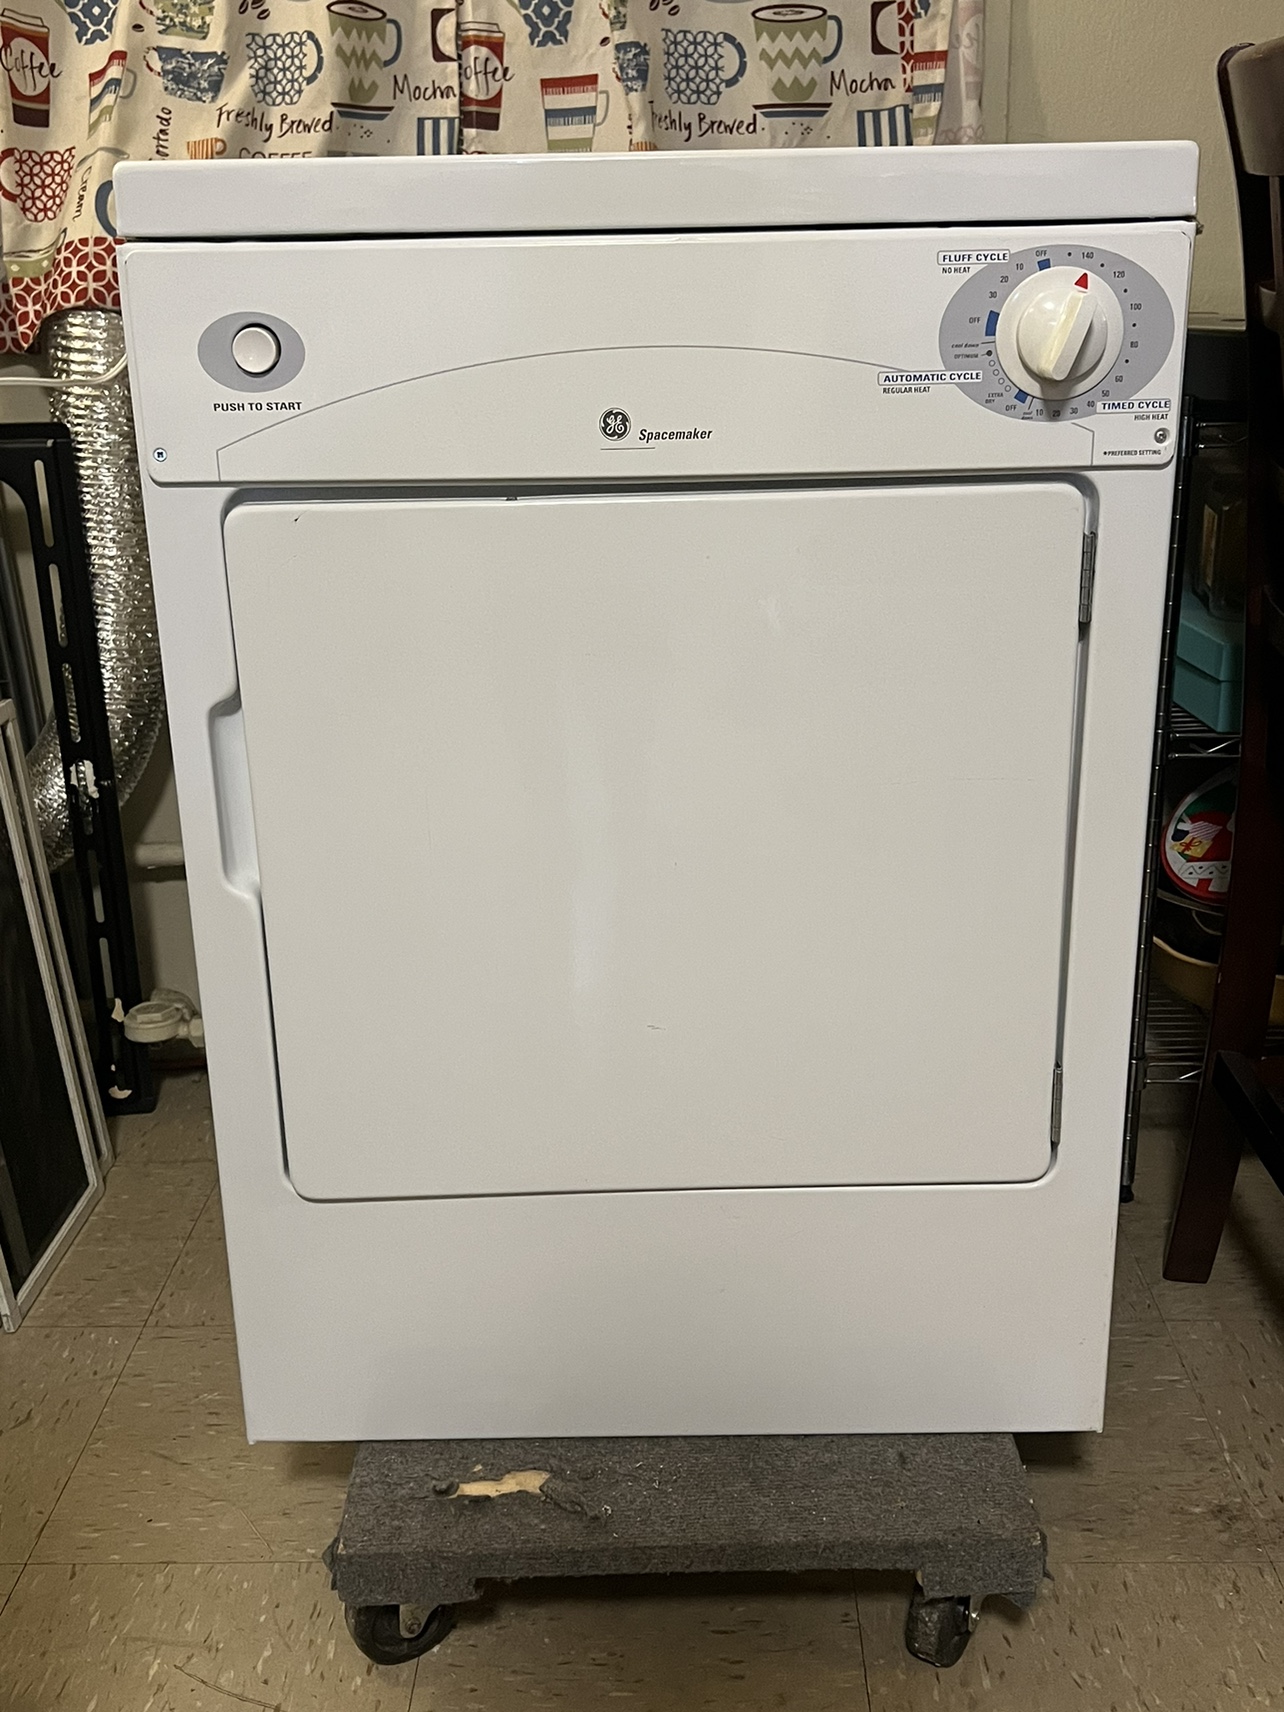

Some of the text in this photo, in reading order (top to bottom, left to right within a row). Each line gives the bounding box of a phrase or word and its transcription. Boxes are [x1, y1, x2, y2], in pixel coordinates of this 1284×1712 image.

[0, 45, 63, 92] Coffee
[463, 57, 516, 97] offee
[393, 73, 457, 102] Mocha
[829, 69, 896, 96] Mocha
[216, 102, 274, 143] Freshly
[150, 106, 173, 160] ortado
[942, 252, 1009, 262] FLUFF CYCLE
[1081, 251, 1095, 259] 140
[953, 266, 971, 274] HEAT
[1113, 270, 1126, 279] 120
[1000, 275, 1009, 283] 20
[988, 291, 998, 299] 30
[968, 316, 981, 324] OFF
[883, 372, 982, 383] AUTOMATIC CYCLE
[1115, 375, 1123, 383] 60
[882, 386, 931, 395] REGULAR HEAT
[213, 401, 303, 412] PUSH TO START
[1087, 400, 1096, 408] 40
[1101, 400, 1170, 410] TIMED CYCLE
[1036, 408, 1044, 416] 10
[638, 427, 713, 444] Spacemaker
